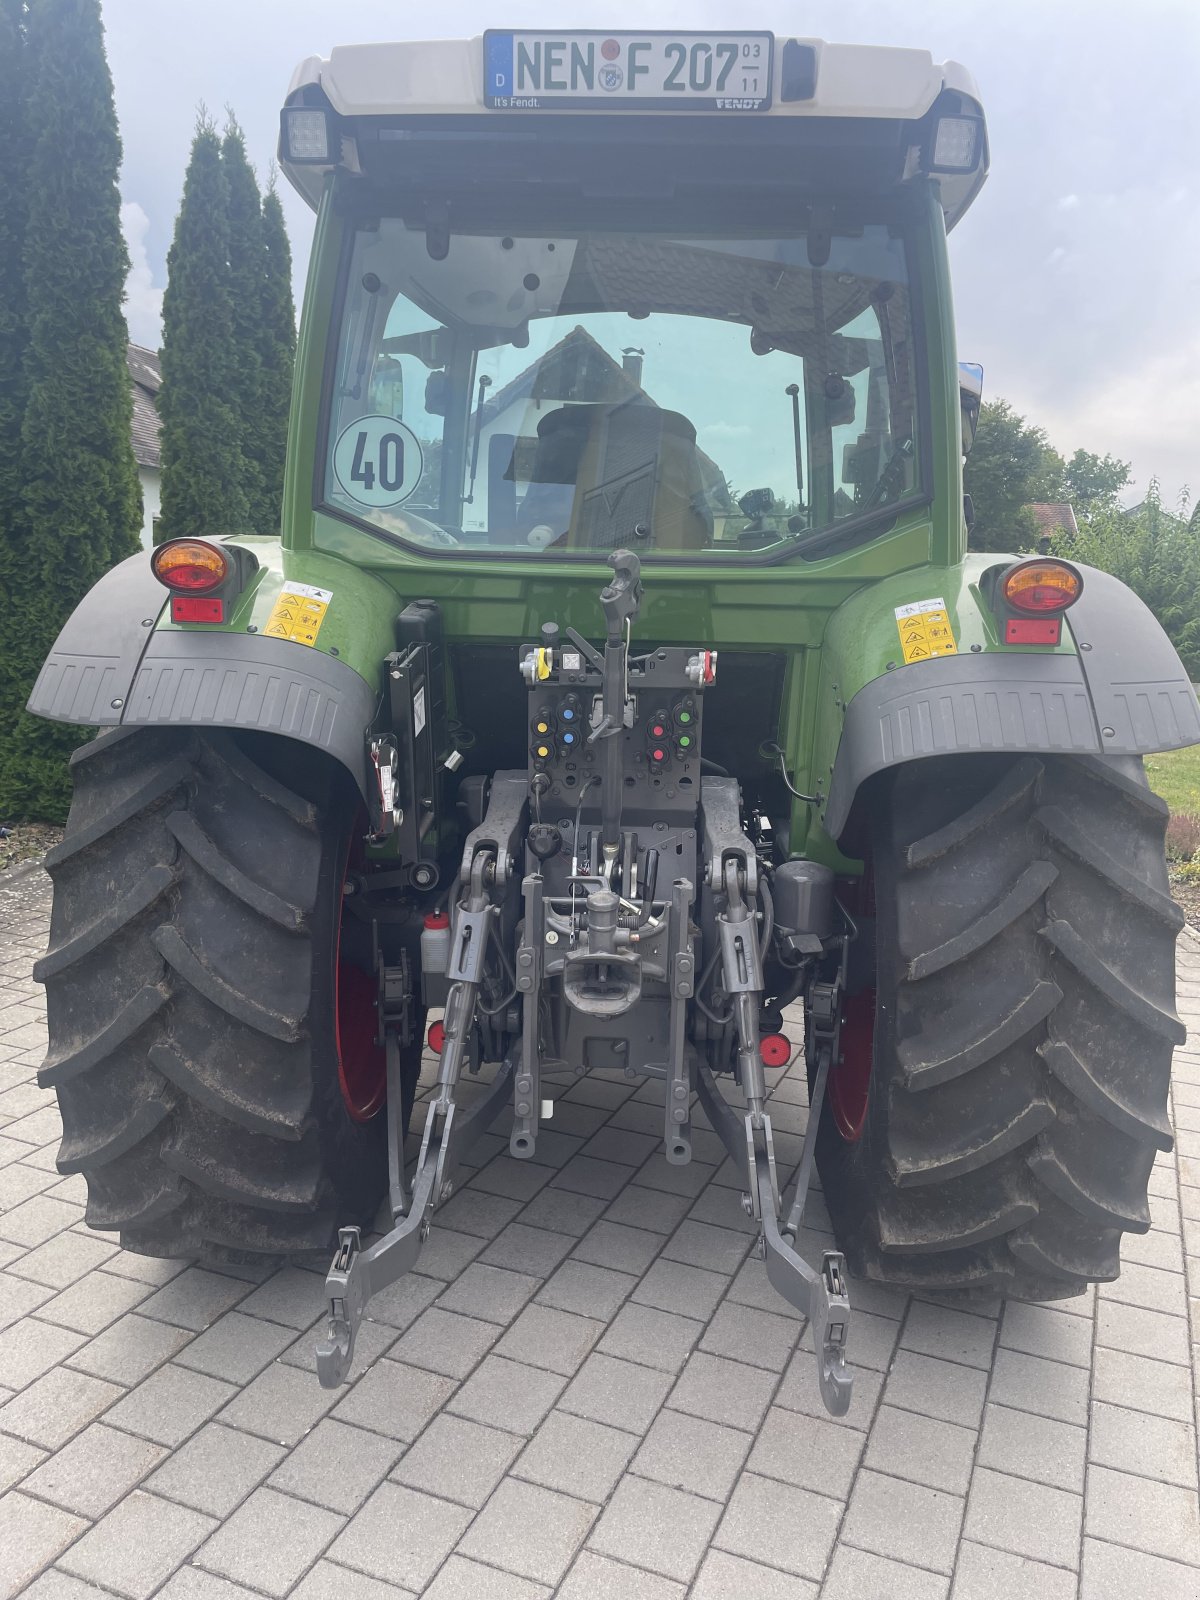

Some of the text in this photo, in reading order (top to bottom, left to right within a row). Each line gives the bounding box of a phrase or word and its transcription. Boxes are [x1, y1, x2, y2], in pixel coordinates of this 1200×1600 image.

[742, 43, 761, 58] 03
[517, 41, 739, 92] NEN F 207
[495, 73, 505, 87] D
[742, 78, 758, 92] 11
[494, 97, 508, 107] It's
[716, 98, 763, 110] FENDT
[350, 431, 405, 492] 40
